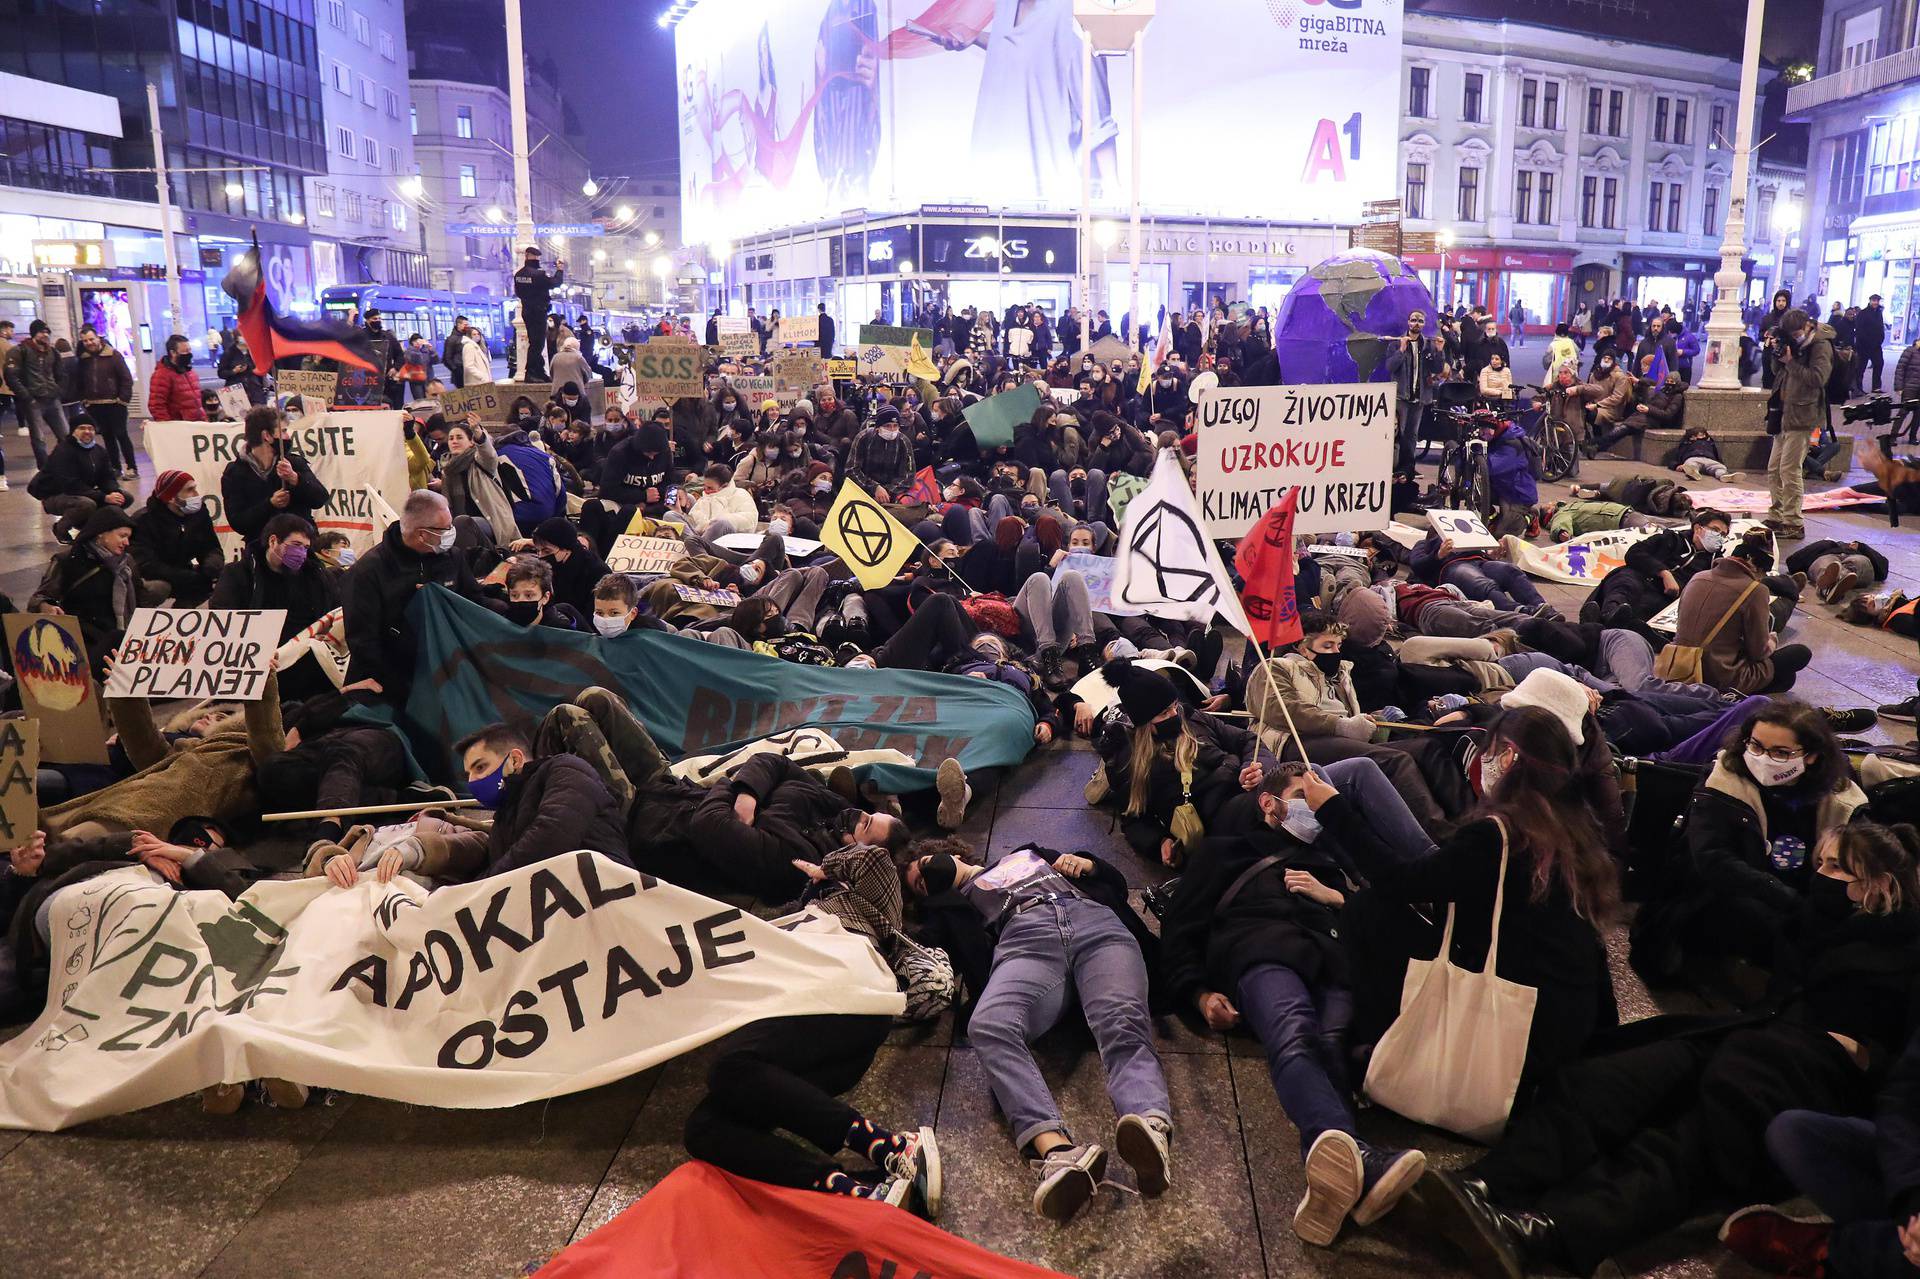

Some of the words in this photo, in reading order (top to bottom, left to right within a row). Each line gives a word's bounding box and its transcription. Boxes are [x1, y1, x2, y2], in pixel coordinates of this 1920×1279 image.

[1299, 14, 1386, 36] gigaBITNA
[1299, 36, 1348, 53] mreža
[1300, 111, 1362, 184] A1
[1209, 238, 1297, 255] HOLDING
[279, 372, 297, 381] WE
[279, 383, 297, 392] FOR
[299, 384, 327, 392] WHAT
[733, 378, 748, 390] GO
[748, 377, 773, 389] VEGAN
[444, 396, 482, 416] PLANET
[485, 394, 497, 409] B
[1203, 397, 1261, 433] UZGOJ
[1282, 389, 1388, 427] ŽIVOTINJA
[1220, 437, 1346, 474] UZROKUJE
[1324, 479, 1386, 516] KRIZU
[1439, 515, 1490, 536] SOS
[639, 550, 672, 560] NOT
[144, 610, 263, 638] DONT
[120, 636, 198, 665] BURN
[203, 640, 262, 669] OUR
[894, 696, 968, 725] ZA
[330, 851, 660, 1011] APOKAL
[436, 908, 757, 1070] OSTAJE
